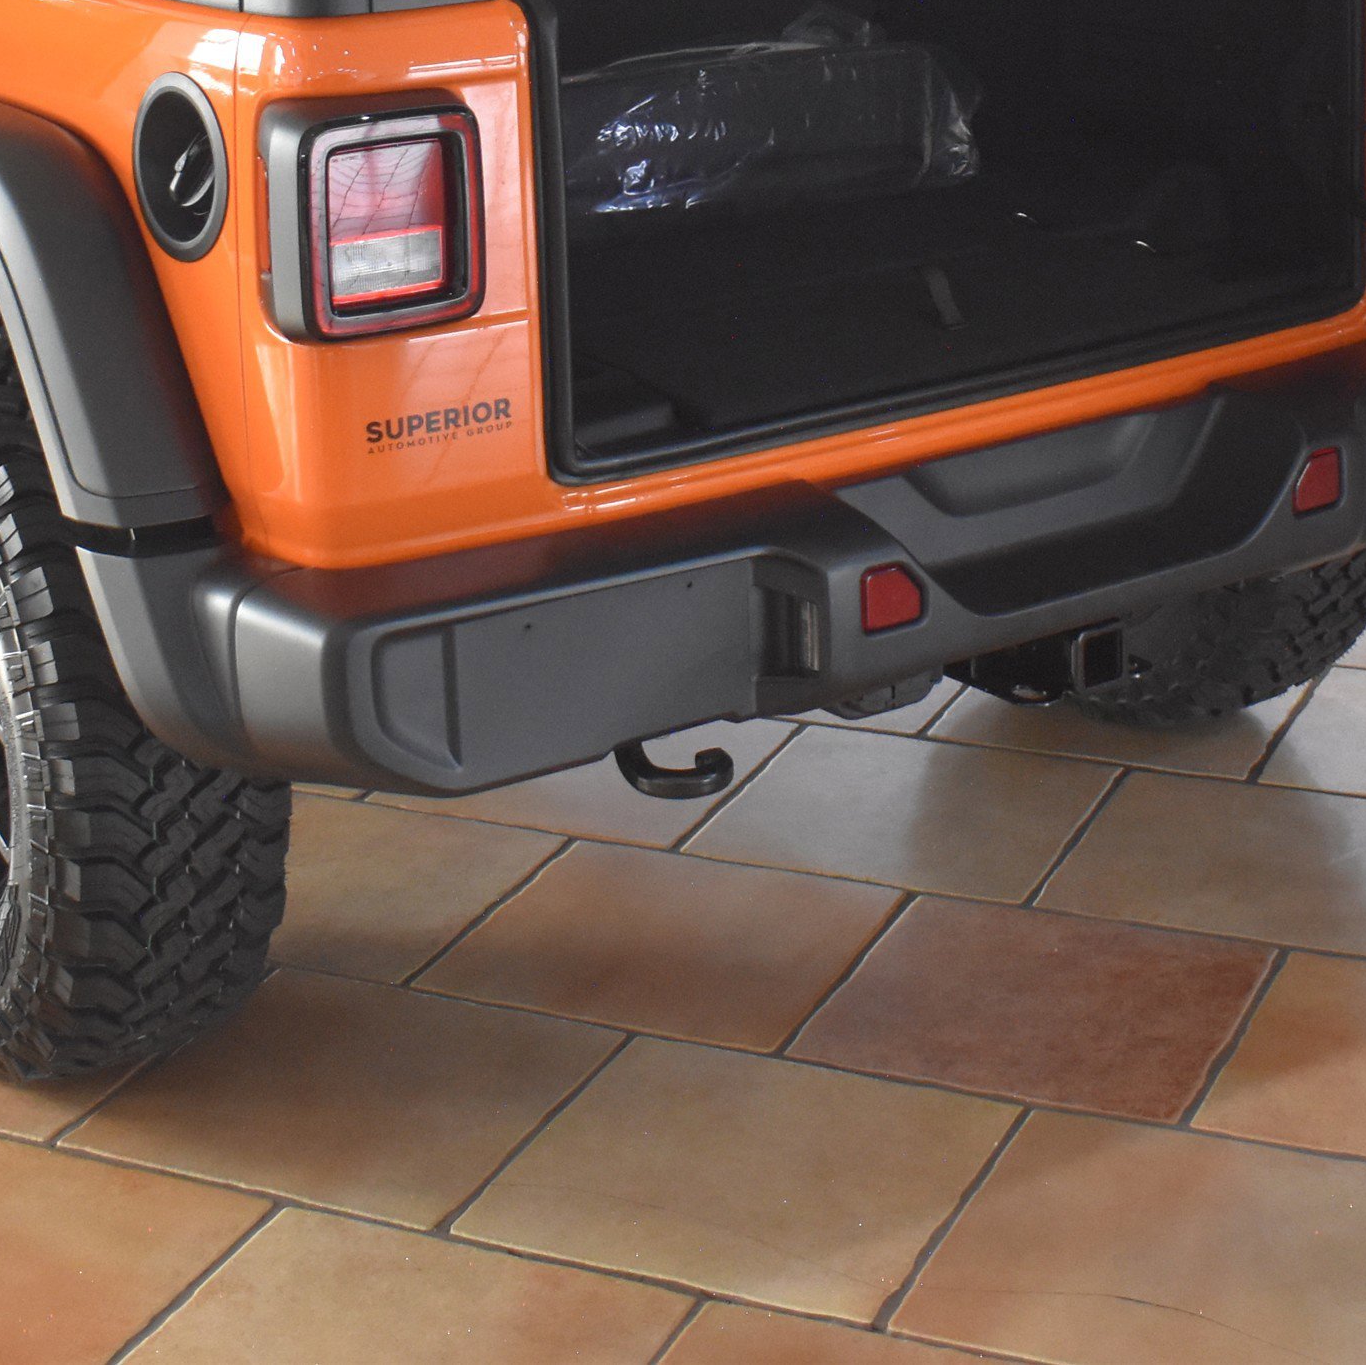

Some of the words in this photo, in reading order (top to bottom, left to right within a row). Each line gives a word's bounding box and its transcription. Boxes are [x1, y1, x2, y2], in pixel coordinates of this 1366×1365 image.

[366, 398, 511, 443] SUPERIOR
[368, 432, 459, 454] AUTOMOTIVE
[466, 421, 513, 437] GROUP
